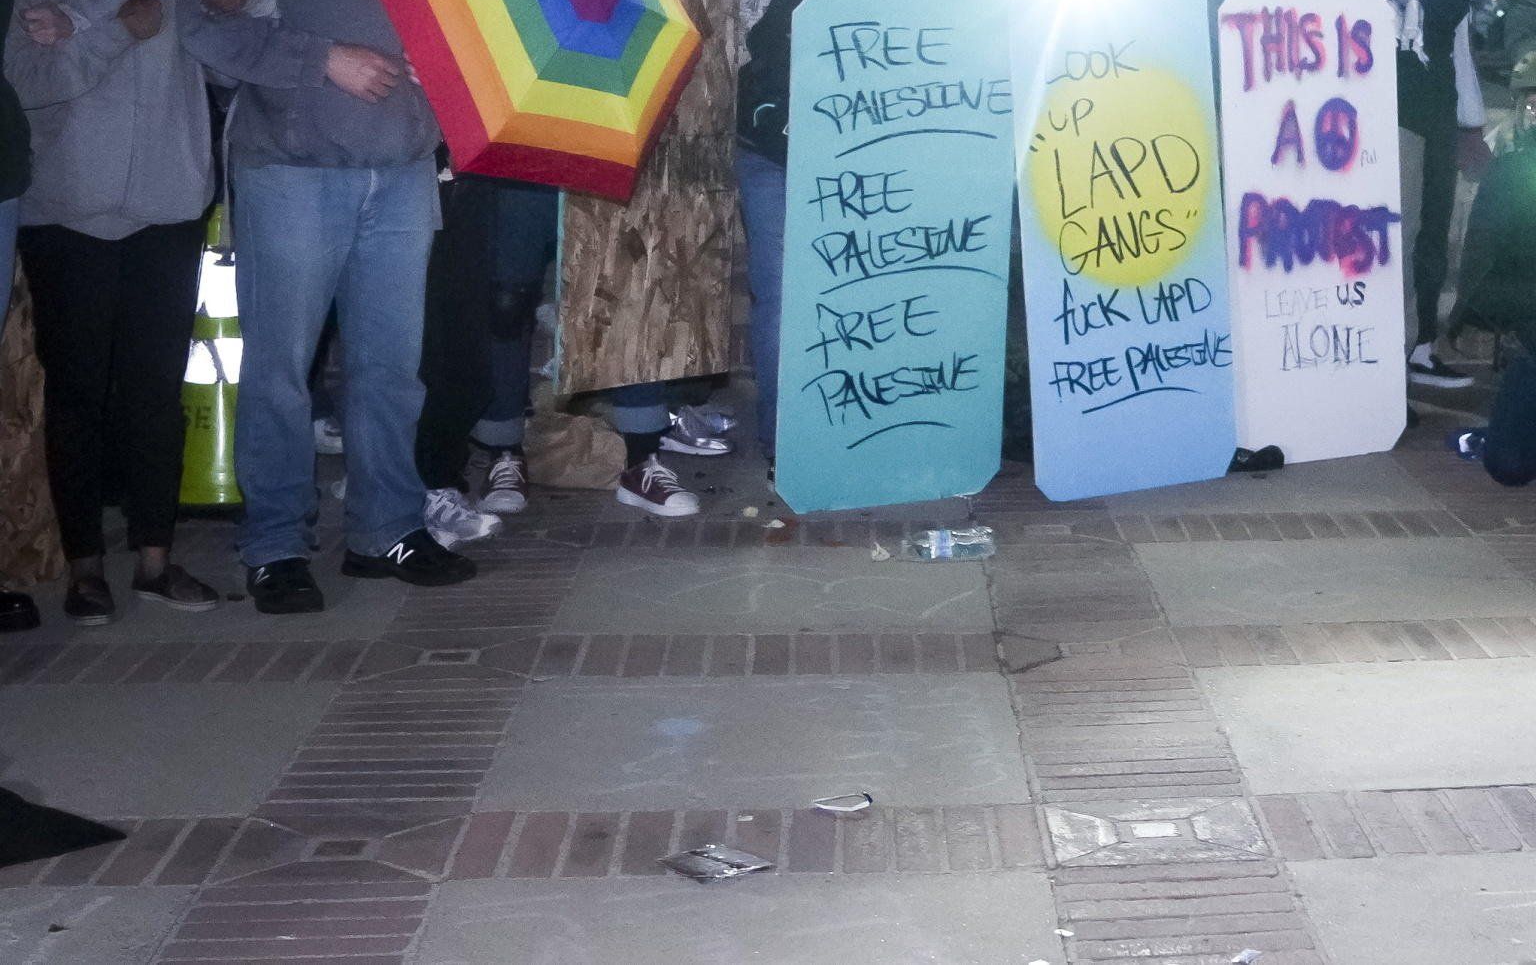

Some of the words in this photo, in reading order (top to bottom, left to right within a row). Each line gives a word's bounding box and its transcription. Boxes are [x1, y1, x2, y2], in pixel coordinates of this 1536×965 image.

[818, 21, 953, 82] FREE
[1222, 5, 1326, 91] THIS
[1334, 11, 1374, 78] IS
[1270, 98, 1306, 170] A
[808, 169, 914, 221] FREE
[811, 214, 993, 280] PALESTINE
[805, 294, 941, 369] FREE
[1136, 277, 1212, 325] LAPD
[801, 351, 980, 427] PALESTINE
[1049, 356, 1123, 399] FREE
[1125, 328, 1233, 392] PALESTINE
